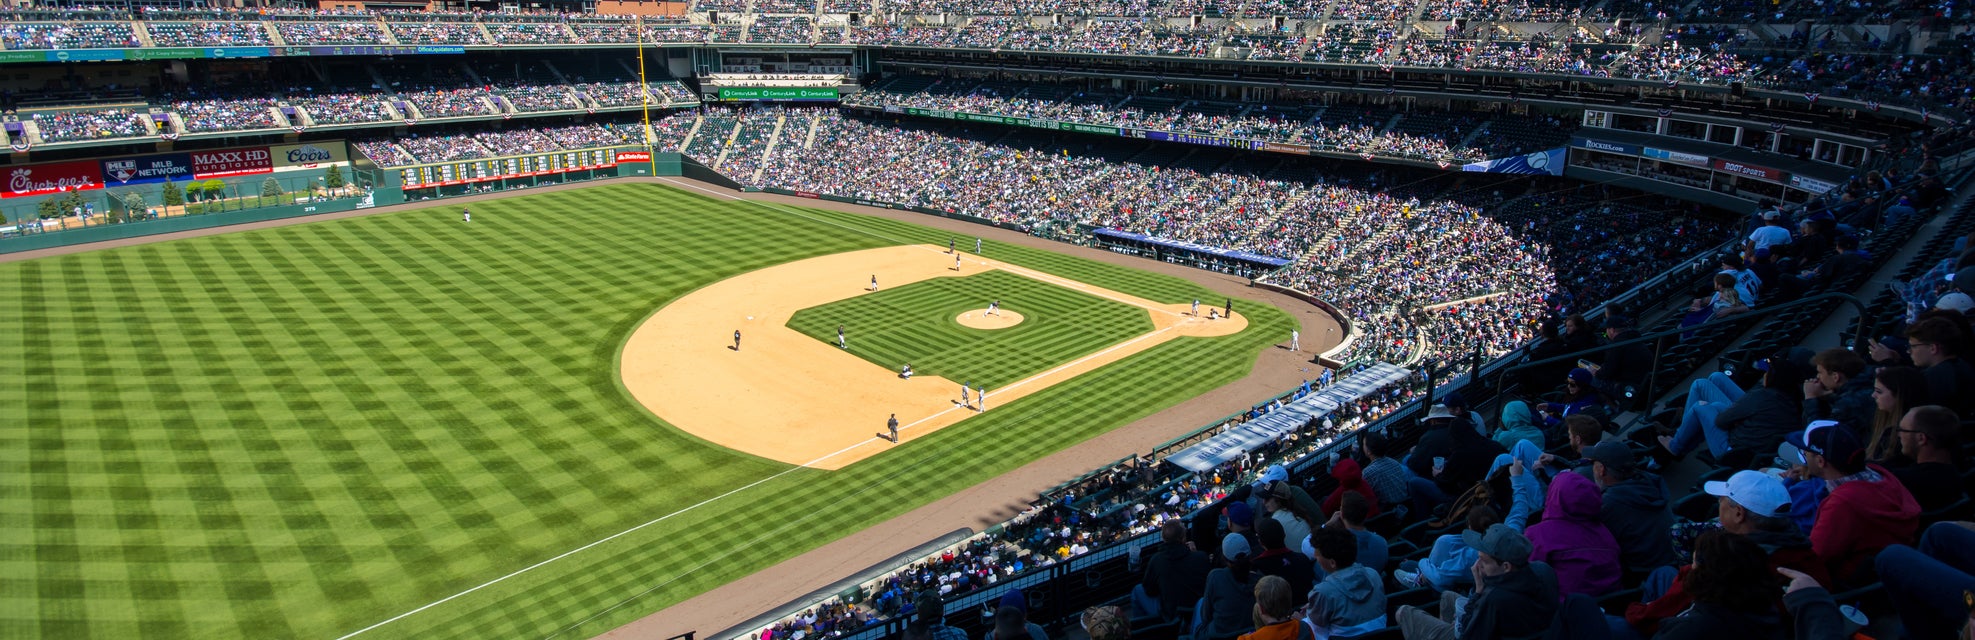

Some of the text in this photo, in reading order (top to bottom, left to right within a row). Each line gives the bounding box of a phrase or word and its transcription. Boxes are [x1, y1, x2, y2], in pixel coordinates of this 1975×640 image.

[194, 150, 268, 165] MAXX HD
[286, 149, 332, 163] Coors
[108, 161, 134, 170] MLB
[138, 166, 188, 176] NETWORK
[195, 159, 270, 171] sunglasses
[1724, 162, 1766, 177] ROOT SPORTS
[1243, 386, 1358, 438] COORS FIELD
[1195, 442, 1232, 460] WELCOME
